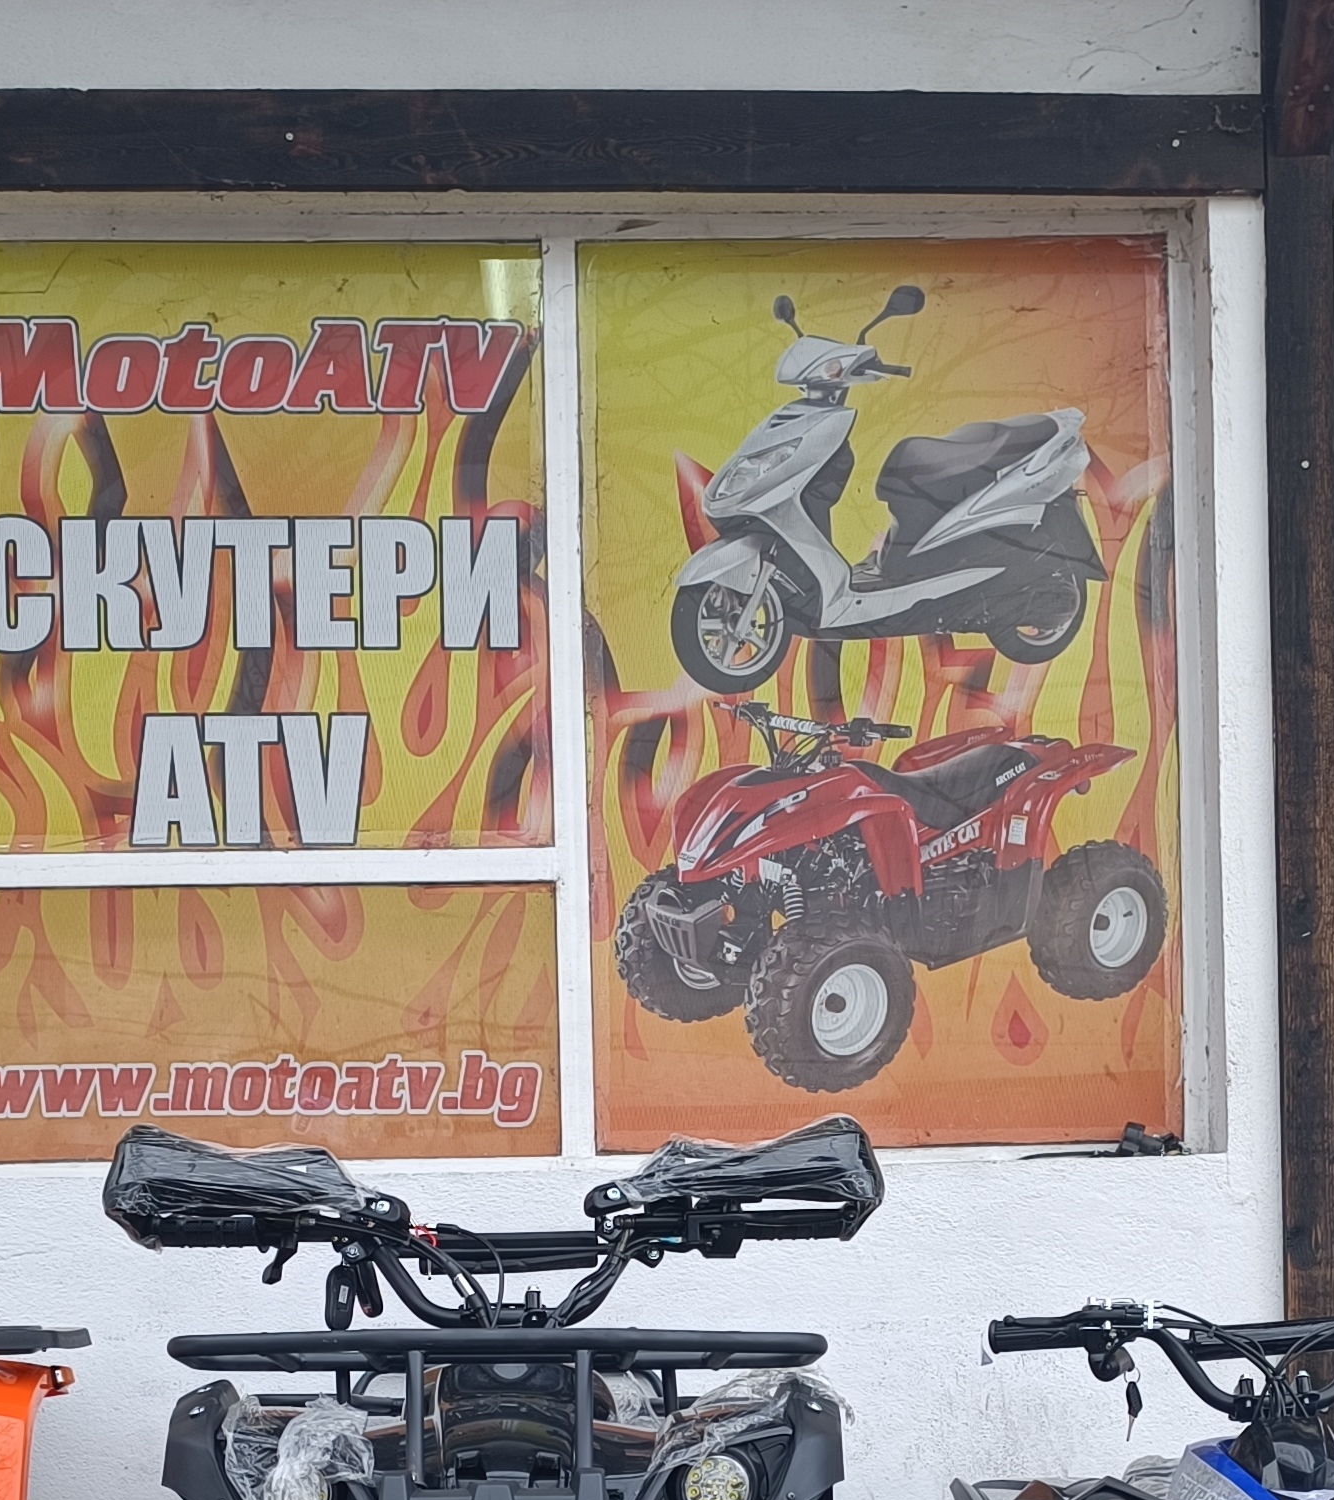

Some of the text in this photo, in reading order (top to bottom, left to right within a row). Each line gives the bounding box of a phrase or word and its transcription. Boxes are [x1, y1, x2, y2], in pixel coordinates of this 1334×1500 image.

[129, 713, 371, 847] ATV
[920, 832, 957, 863] RCTIC
[957, 821, 981, 844] CAT
